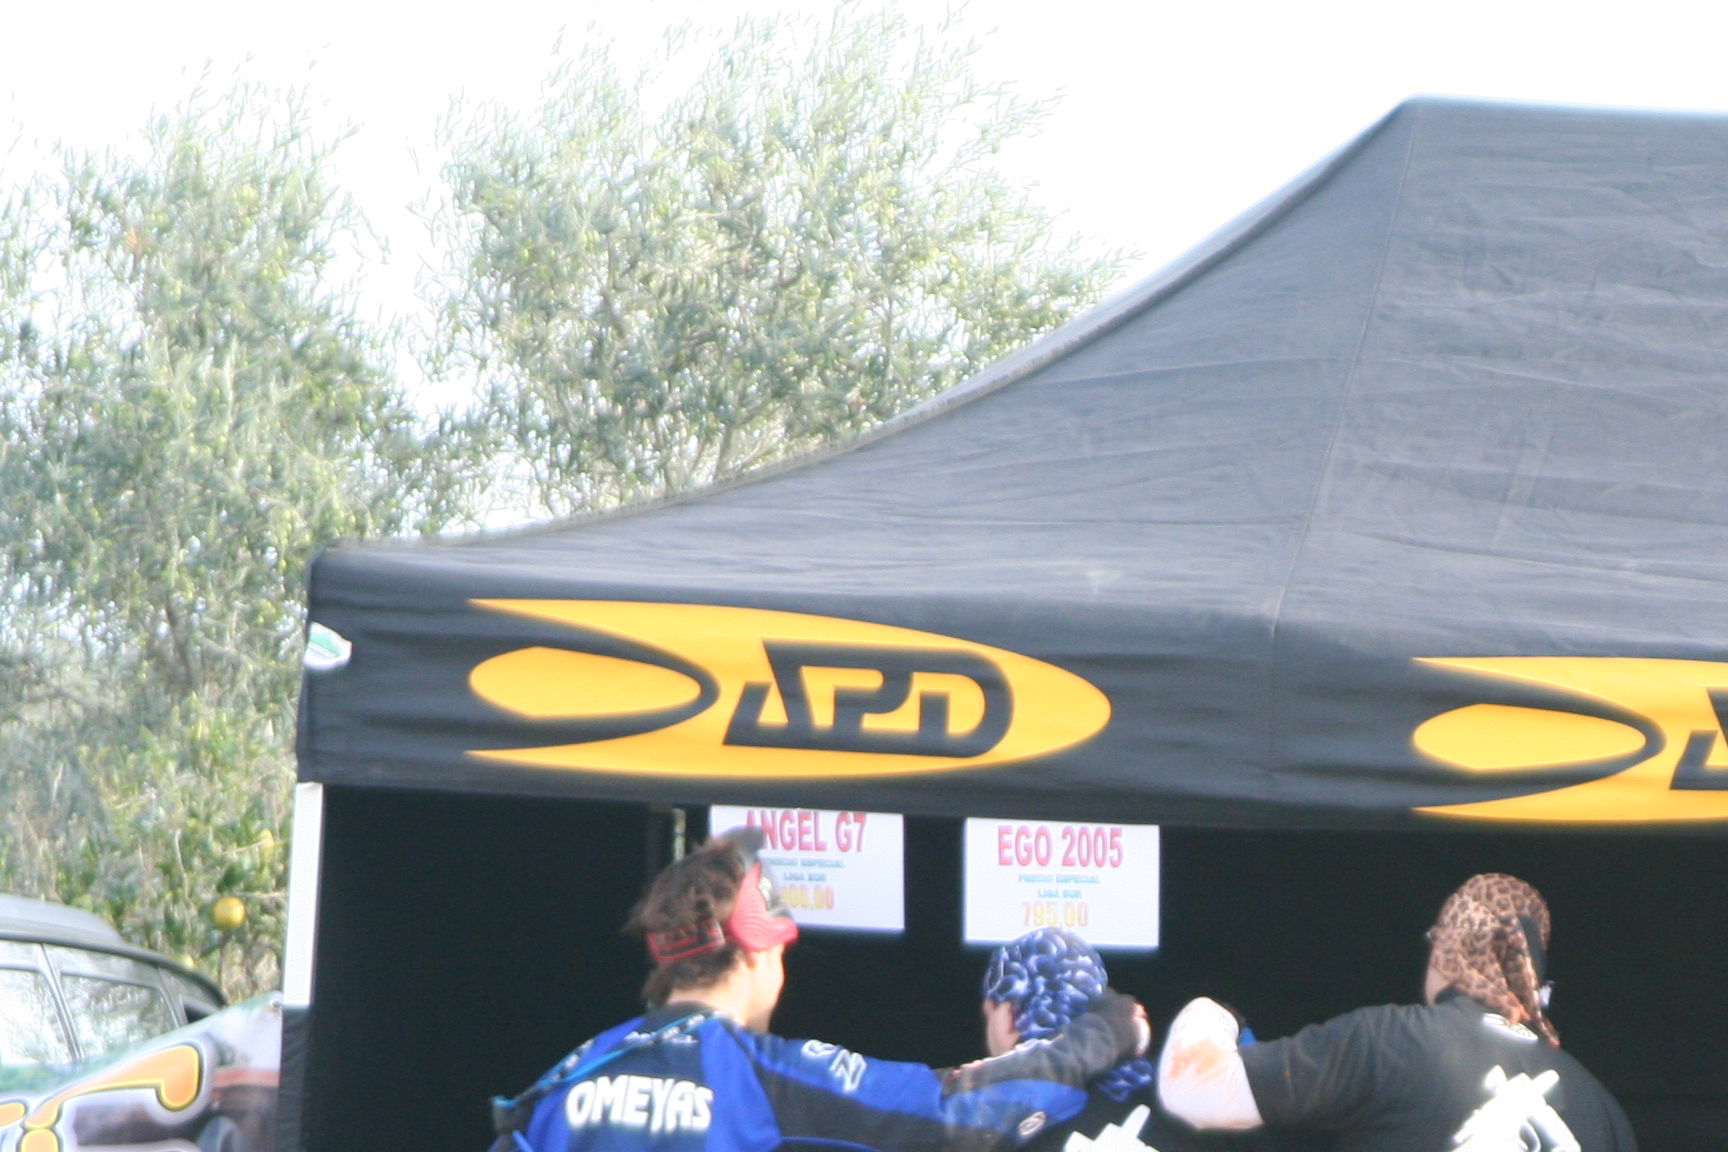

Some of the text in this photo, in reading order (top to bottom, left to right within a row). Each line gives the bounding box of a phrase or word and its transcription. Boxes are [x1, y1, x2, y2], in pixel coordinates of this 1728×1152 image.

[835, 811, 867, 852] G7
[997, 825, 1124, 868] EGO 2005
[566, 1074, 714, 1132] OMEYAS
